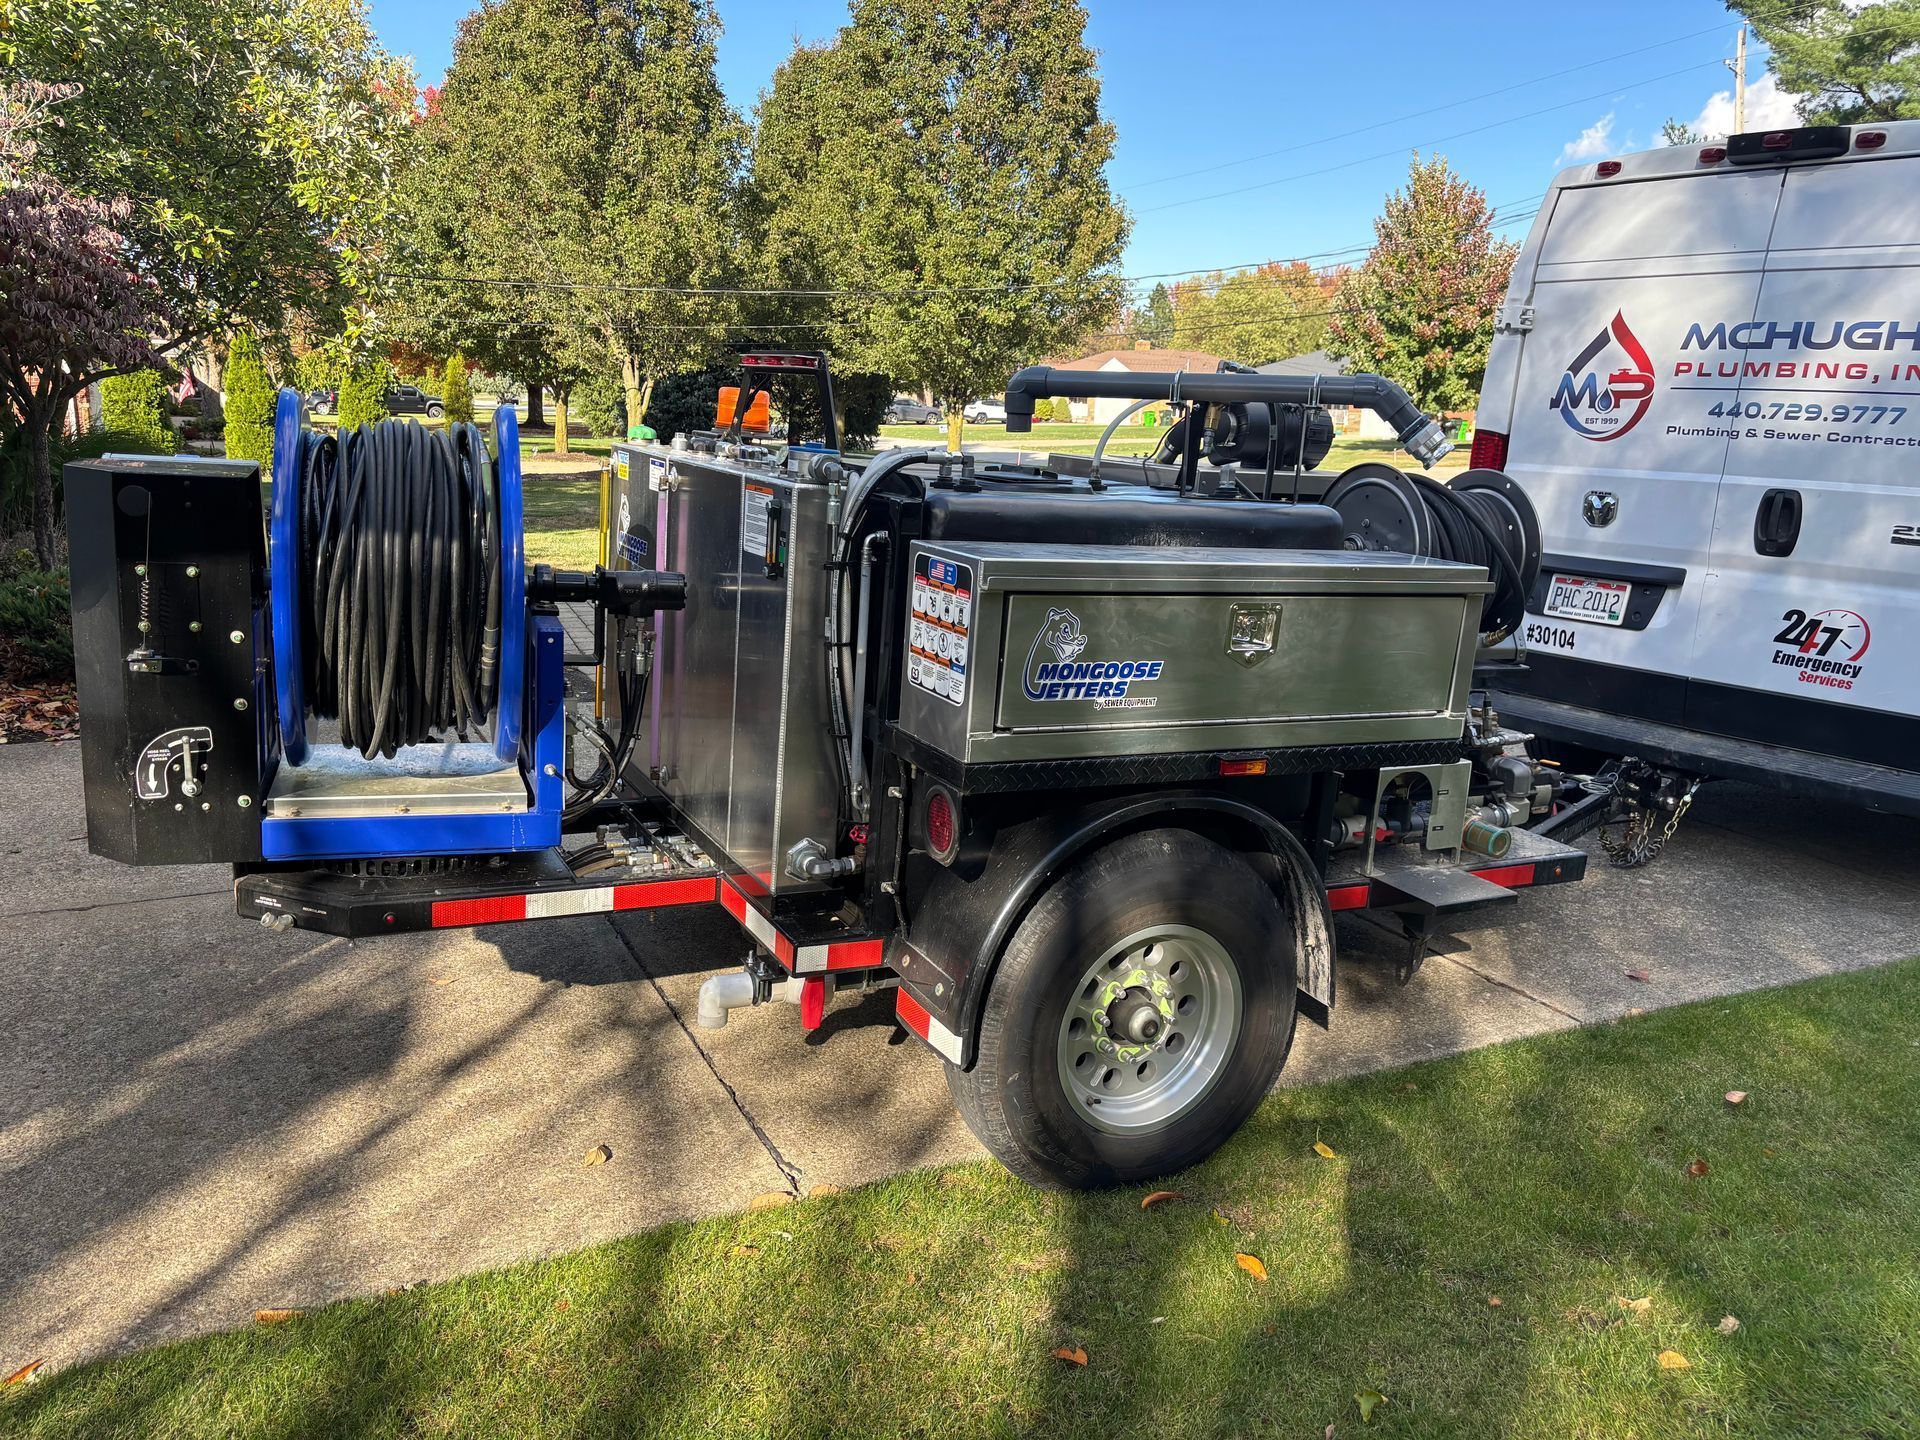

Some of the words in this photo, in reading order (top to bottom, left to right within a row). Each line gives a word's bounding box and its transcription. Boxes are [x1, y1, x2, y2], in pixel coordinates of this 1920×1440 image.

[1680, 321, 1920, 350] MCHUGH
[1674, 361, 1880, 384] PLUMBING,
[1585, 417, 1600, 425] EST
[1601, 417, 1619, 425] 1999
[1707, 401, 1907, 425] 440.729.9777
[1666, 425, 1740, 439] Plumbing
[1745, 428, 1758, 439] &
[1763, 428, 1821, 442] Sewer
[1553, 586, 1580, 608] PHC
[1582, 591, 1620, 614] 2012
[1527, 623, 1575, 649] #30104
[1036, 661, 1163, 682] MONGOOSE
[1772, 650, 1862, 678] Emergency
[1031, 681, 1129, 700] JETTERS
[1798, 671, 1853, 690] Services
[1094, 699, 1104, 709] by
[1104, 699, 1123, 707] SEWER
[1124, 698, 1157, 707] EQUIPMENT
